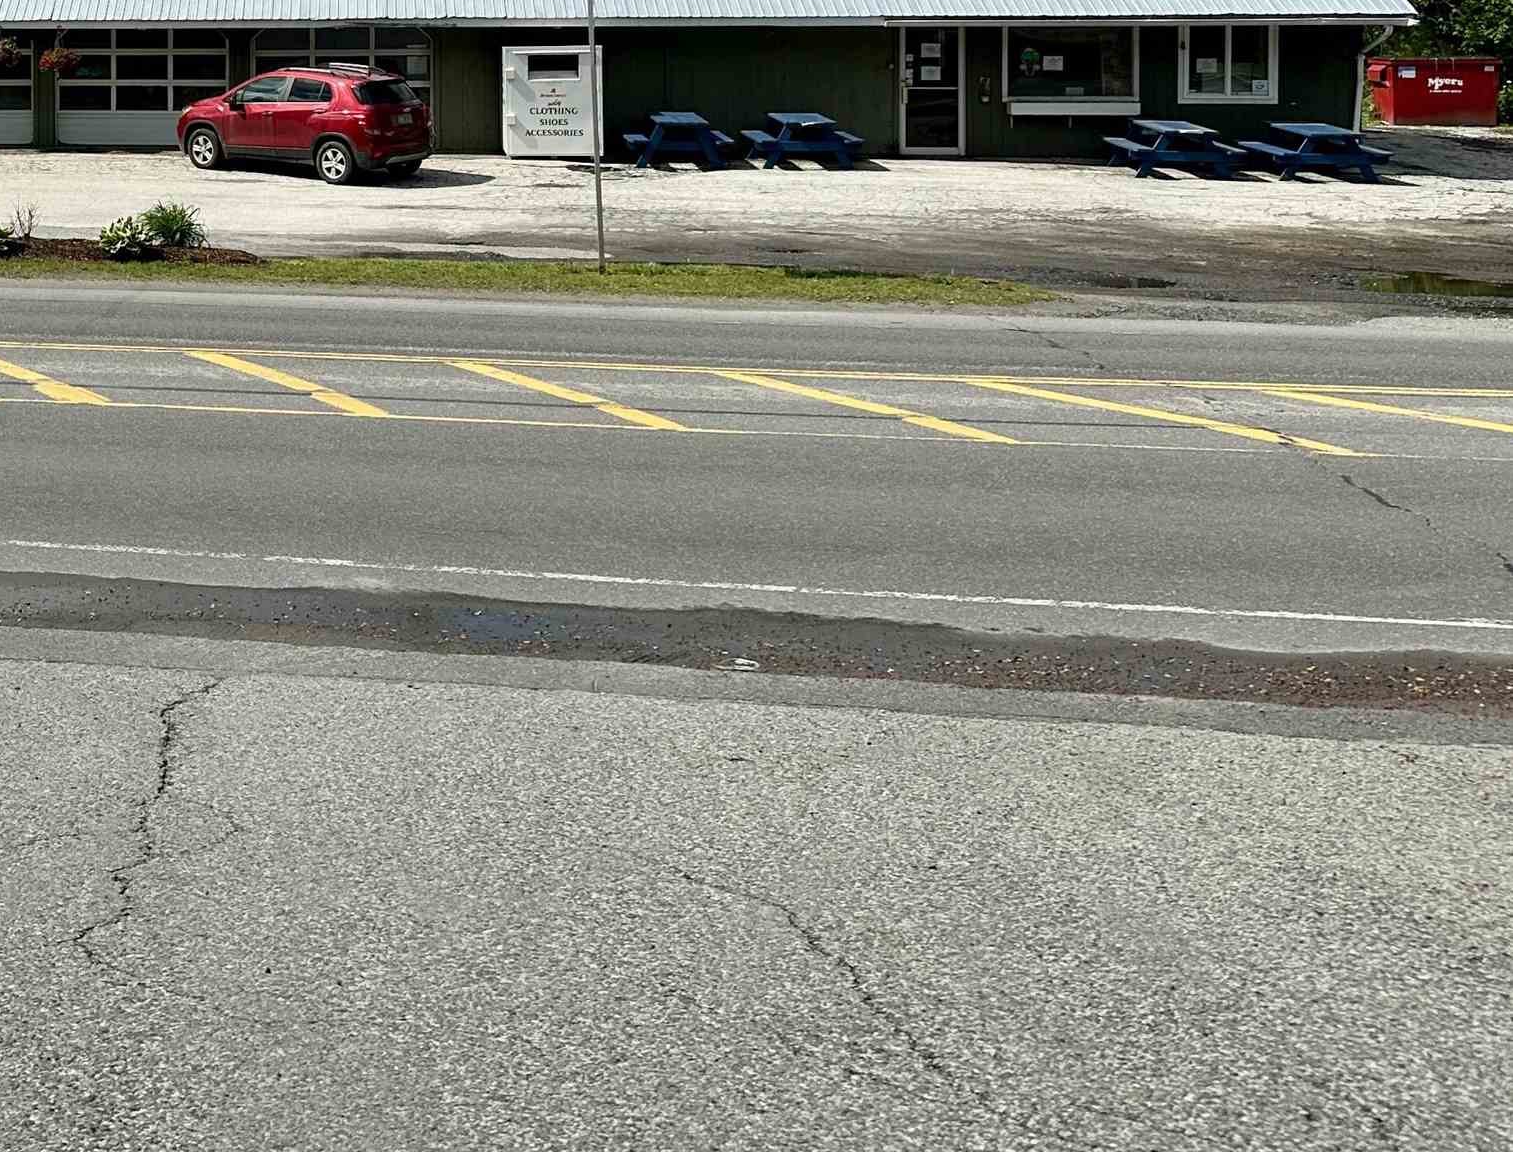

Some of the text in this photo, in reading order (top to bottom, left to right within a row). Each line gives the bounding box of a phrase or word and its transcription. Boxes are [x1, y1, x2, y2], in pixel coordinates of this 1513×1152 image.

[529, 107, 578, 115] CLOTHING
[539, 118, 568, 126] SHOES
[525, 129, 584, 137] ACCESSORIES
